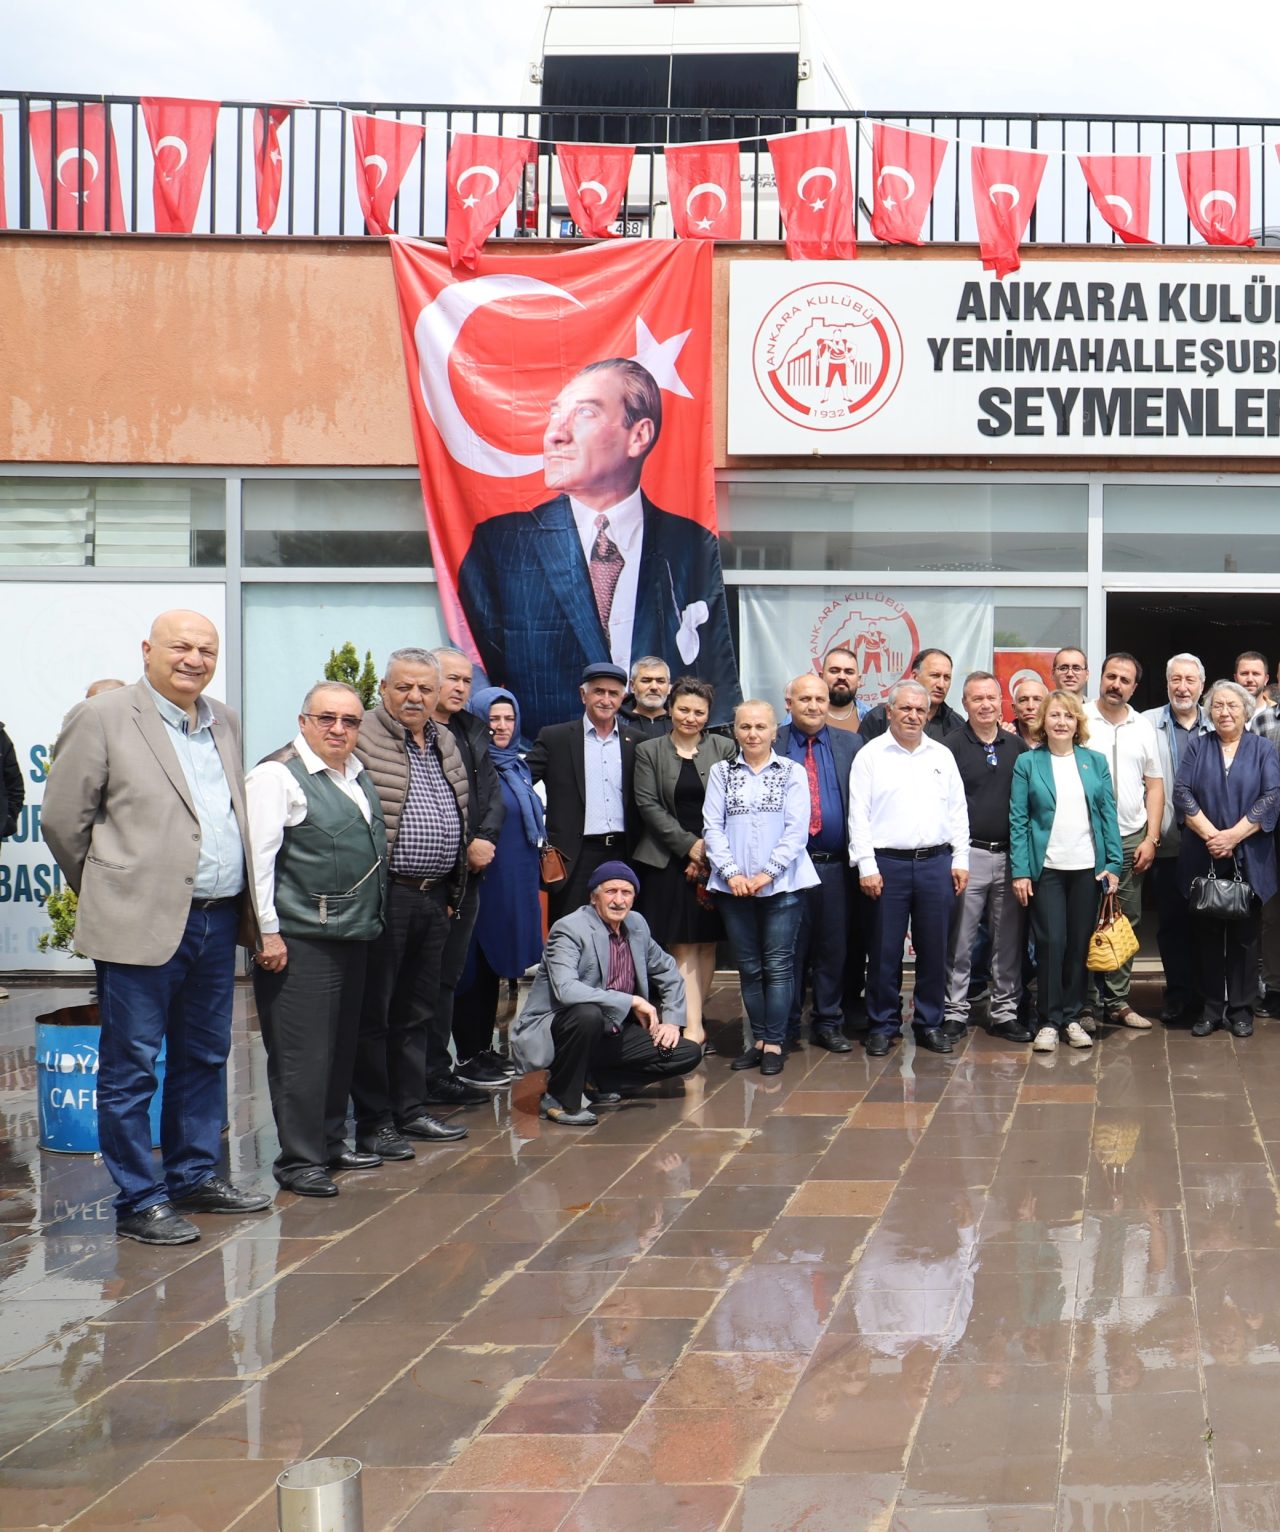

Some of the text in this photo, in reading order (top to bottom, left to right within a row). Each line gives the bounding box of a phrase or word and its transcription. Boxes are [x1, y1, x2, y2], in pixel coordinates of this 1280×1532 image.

[957, 282, 1149, 322] ANKARA
[767, 296, 874, 366] ANKARA KULÜBÜ
[814, 409, 846, 419] 1932
[810, 591, 905, 654] ANKARA KULÜBÜ
[855, 692, 879, 701] 932
